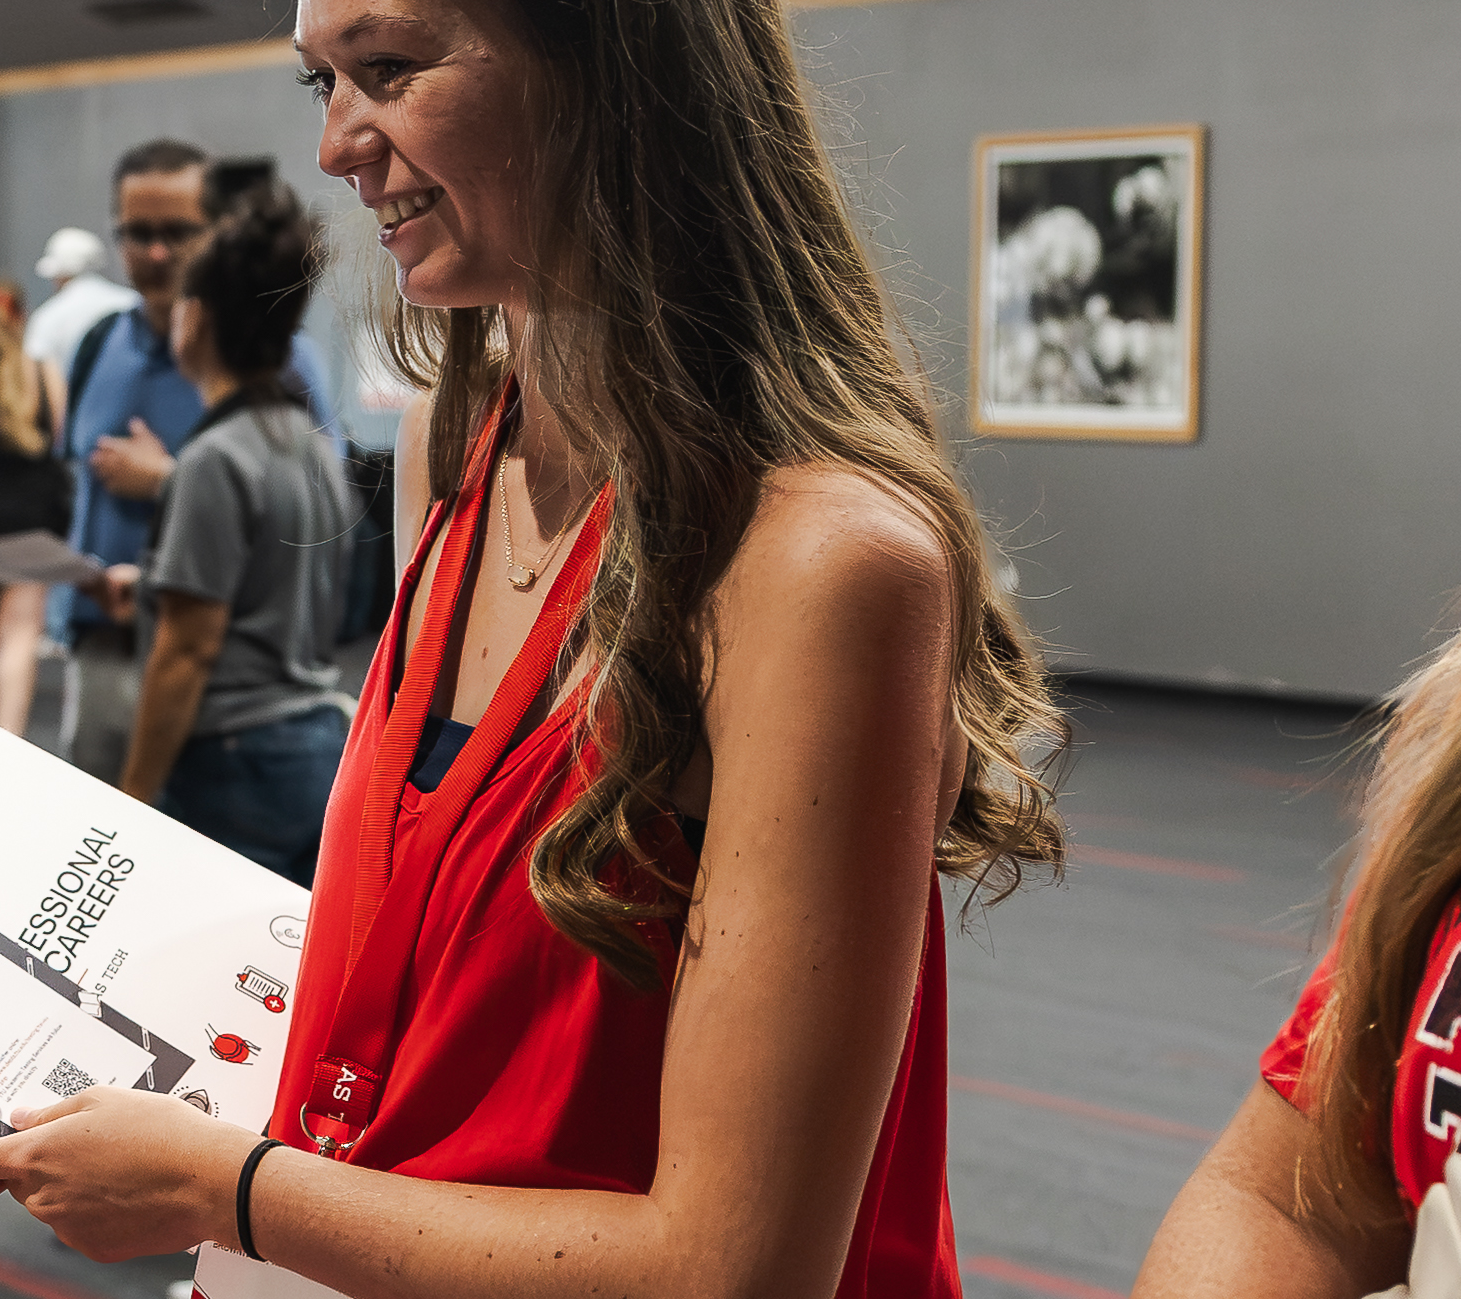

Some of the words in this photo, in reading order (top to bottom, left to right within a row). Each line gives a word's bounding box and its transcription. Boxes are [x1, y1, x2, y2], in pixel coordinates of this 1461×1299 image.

[18, 827, 117, 951] ESSIONAL
[44, 853, 134, 974] CAREERS
[101, 948, 129, 980] TECH
